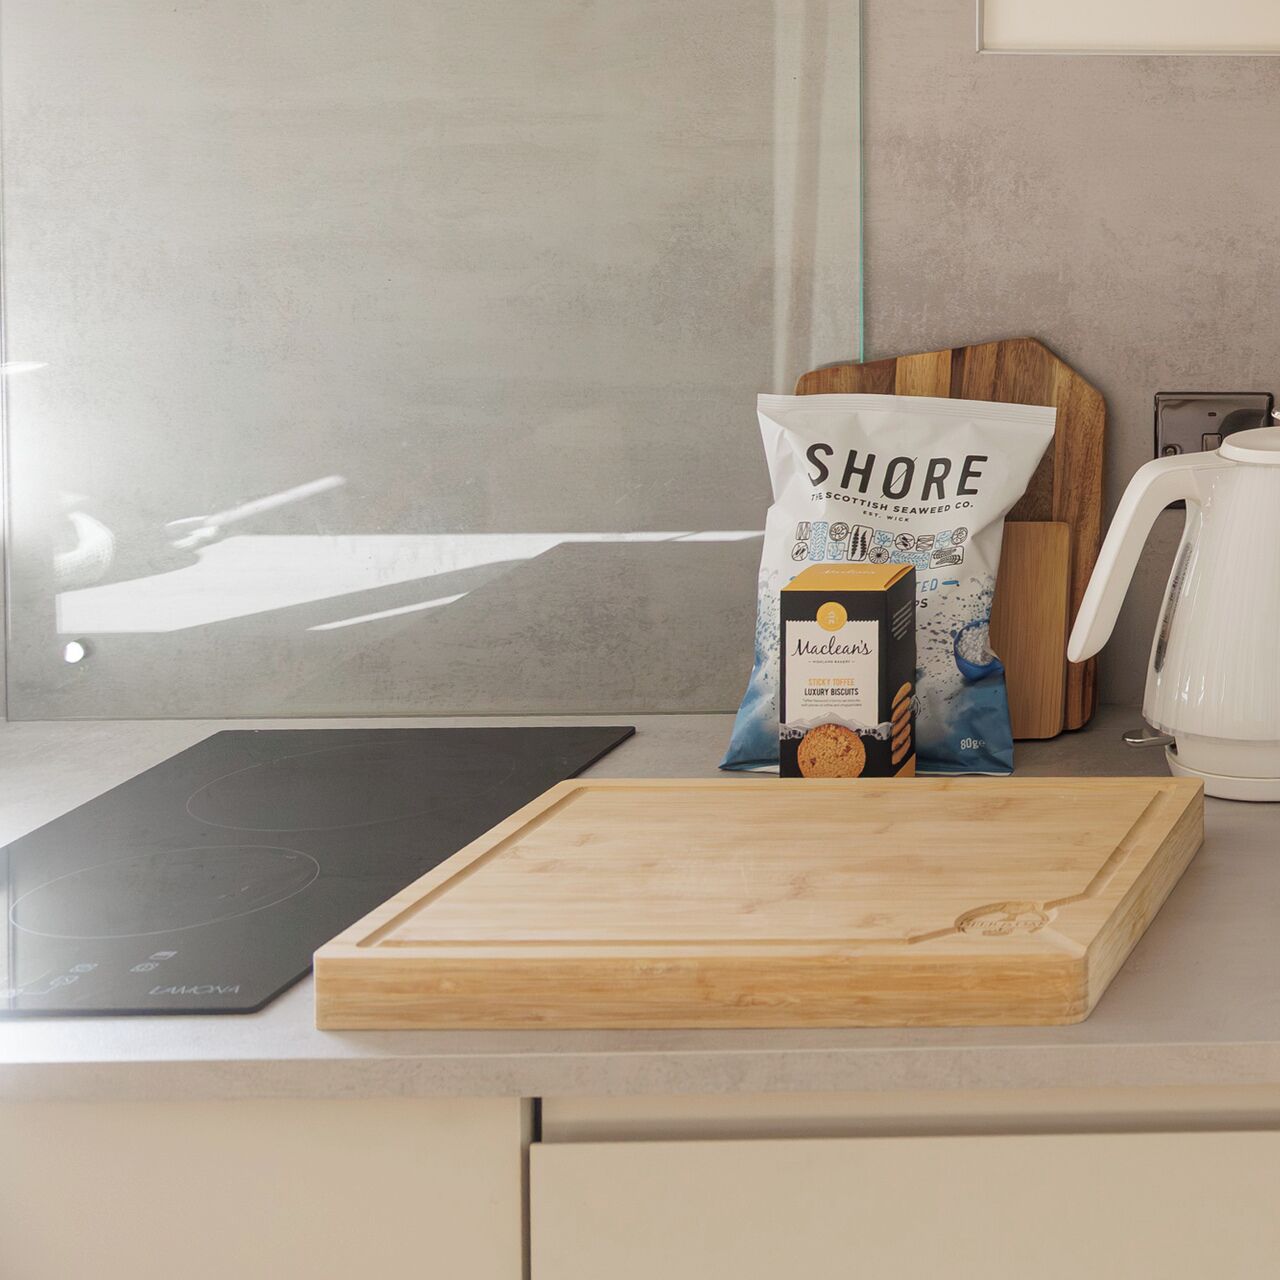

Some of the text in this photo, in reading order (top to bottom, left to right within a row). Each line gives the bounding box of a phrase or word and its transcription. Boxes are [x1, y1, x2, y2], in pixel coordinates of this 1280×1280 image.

[825, 491, 888, 511] SCOTTISH
[893, 504, 951, 515] SEAWEED
[955, 500, 974, 510] CO.
[862, 510, 882, 519] EST.
[791, 635, 873, 656] Maclean's
[808, 678, 856, 686] STICKY TOFFEE
[804, 687, 859, 696] LUXURY BISCUITS
